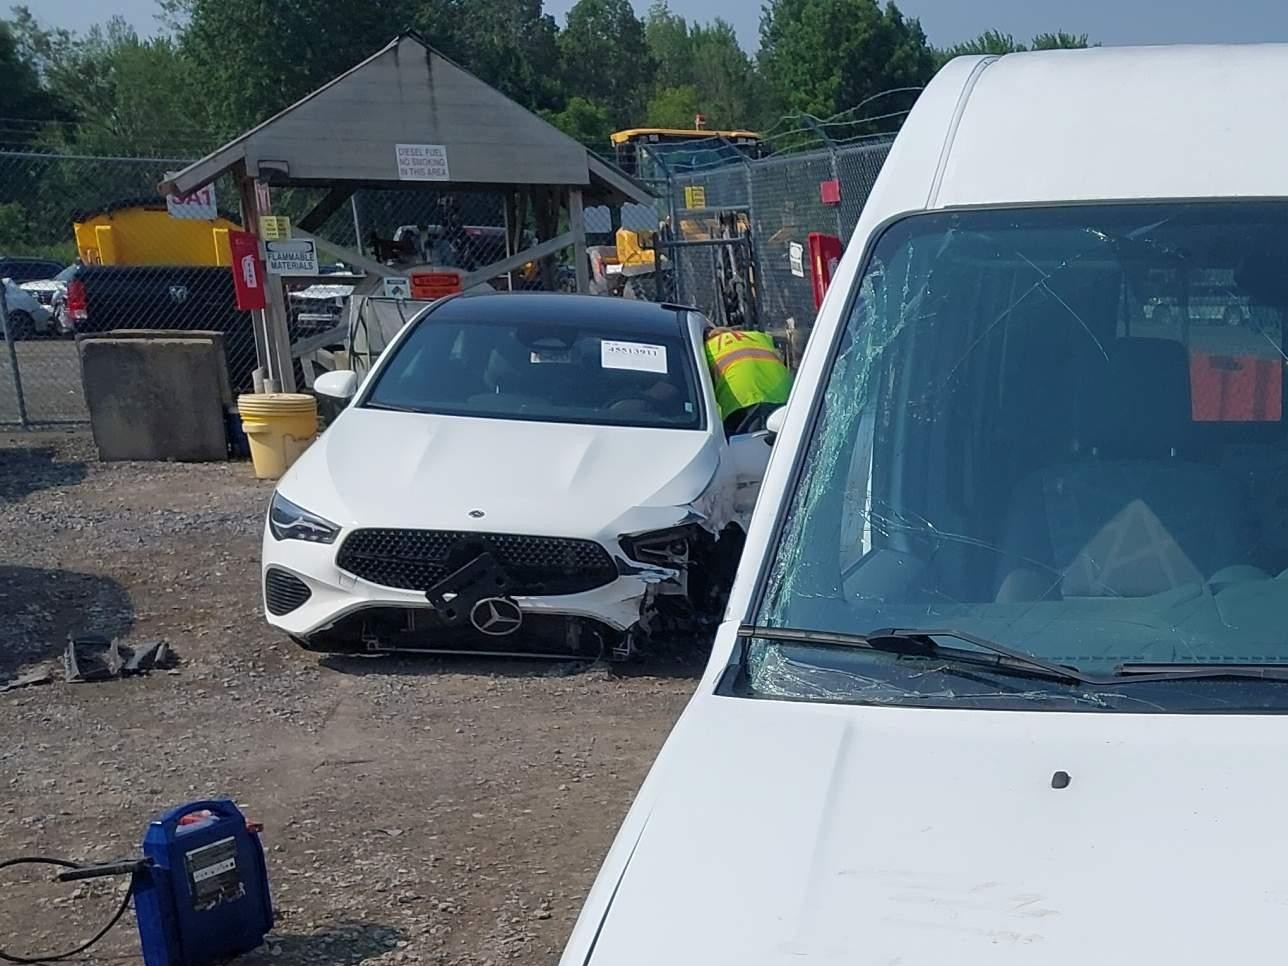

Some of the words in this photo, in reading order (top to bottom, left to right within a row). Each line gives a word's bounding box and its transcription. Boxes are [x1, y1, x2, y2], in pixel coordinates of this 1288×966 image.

[399, 148, 424, 156] DIESEL
[425, 148, 443, 157] FUEL
[400, 158, 411, 166] NO
[268, 252, 315, 261] FLAMMABLE
[271, 261, 314, 270] MATERIALS
